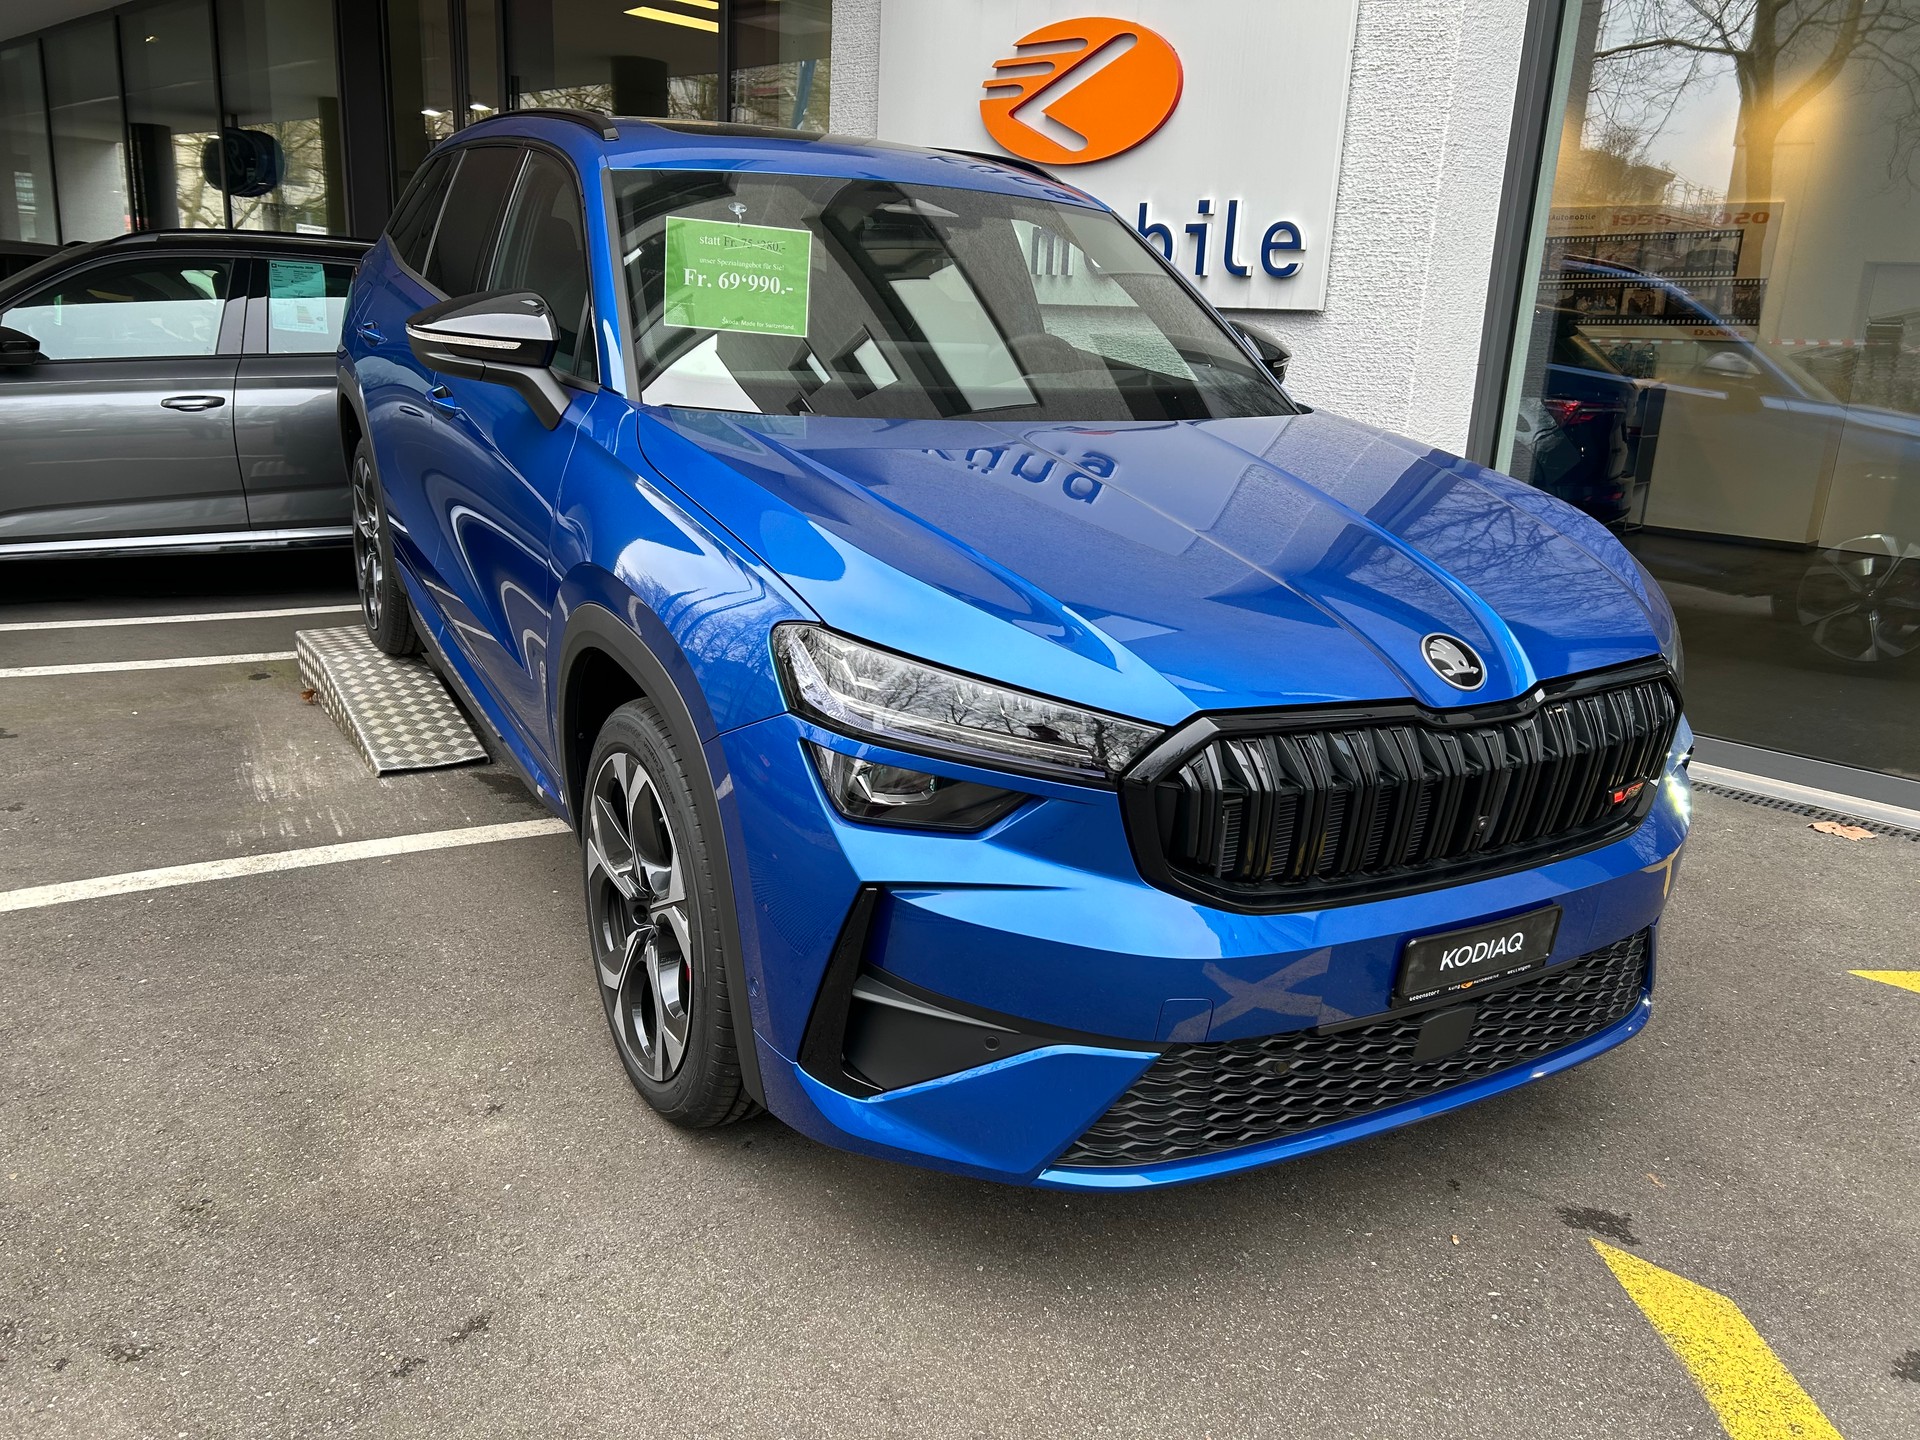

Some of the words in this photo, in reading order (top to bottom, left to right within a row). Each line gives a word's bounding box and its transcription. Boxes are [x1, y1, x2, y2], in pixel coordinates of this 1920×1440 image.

[699, 235, 721, 247] statt
[717, 258, 762, 269] Spezialangebot
[763, 262, 772, 270] für
[683, 267, 712, 288] Fr.
[718, 271, 794, 295] 69'990.-
[1439, 932, 1524, 972] KODIAQ
